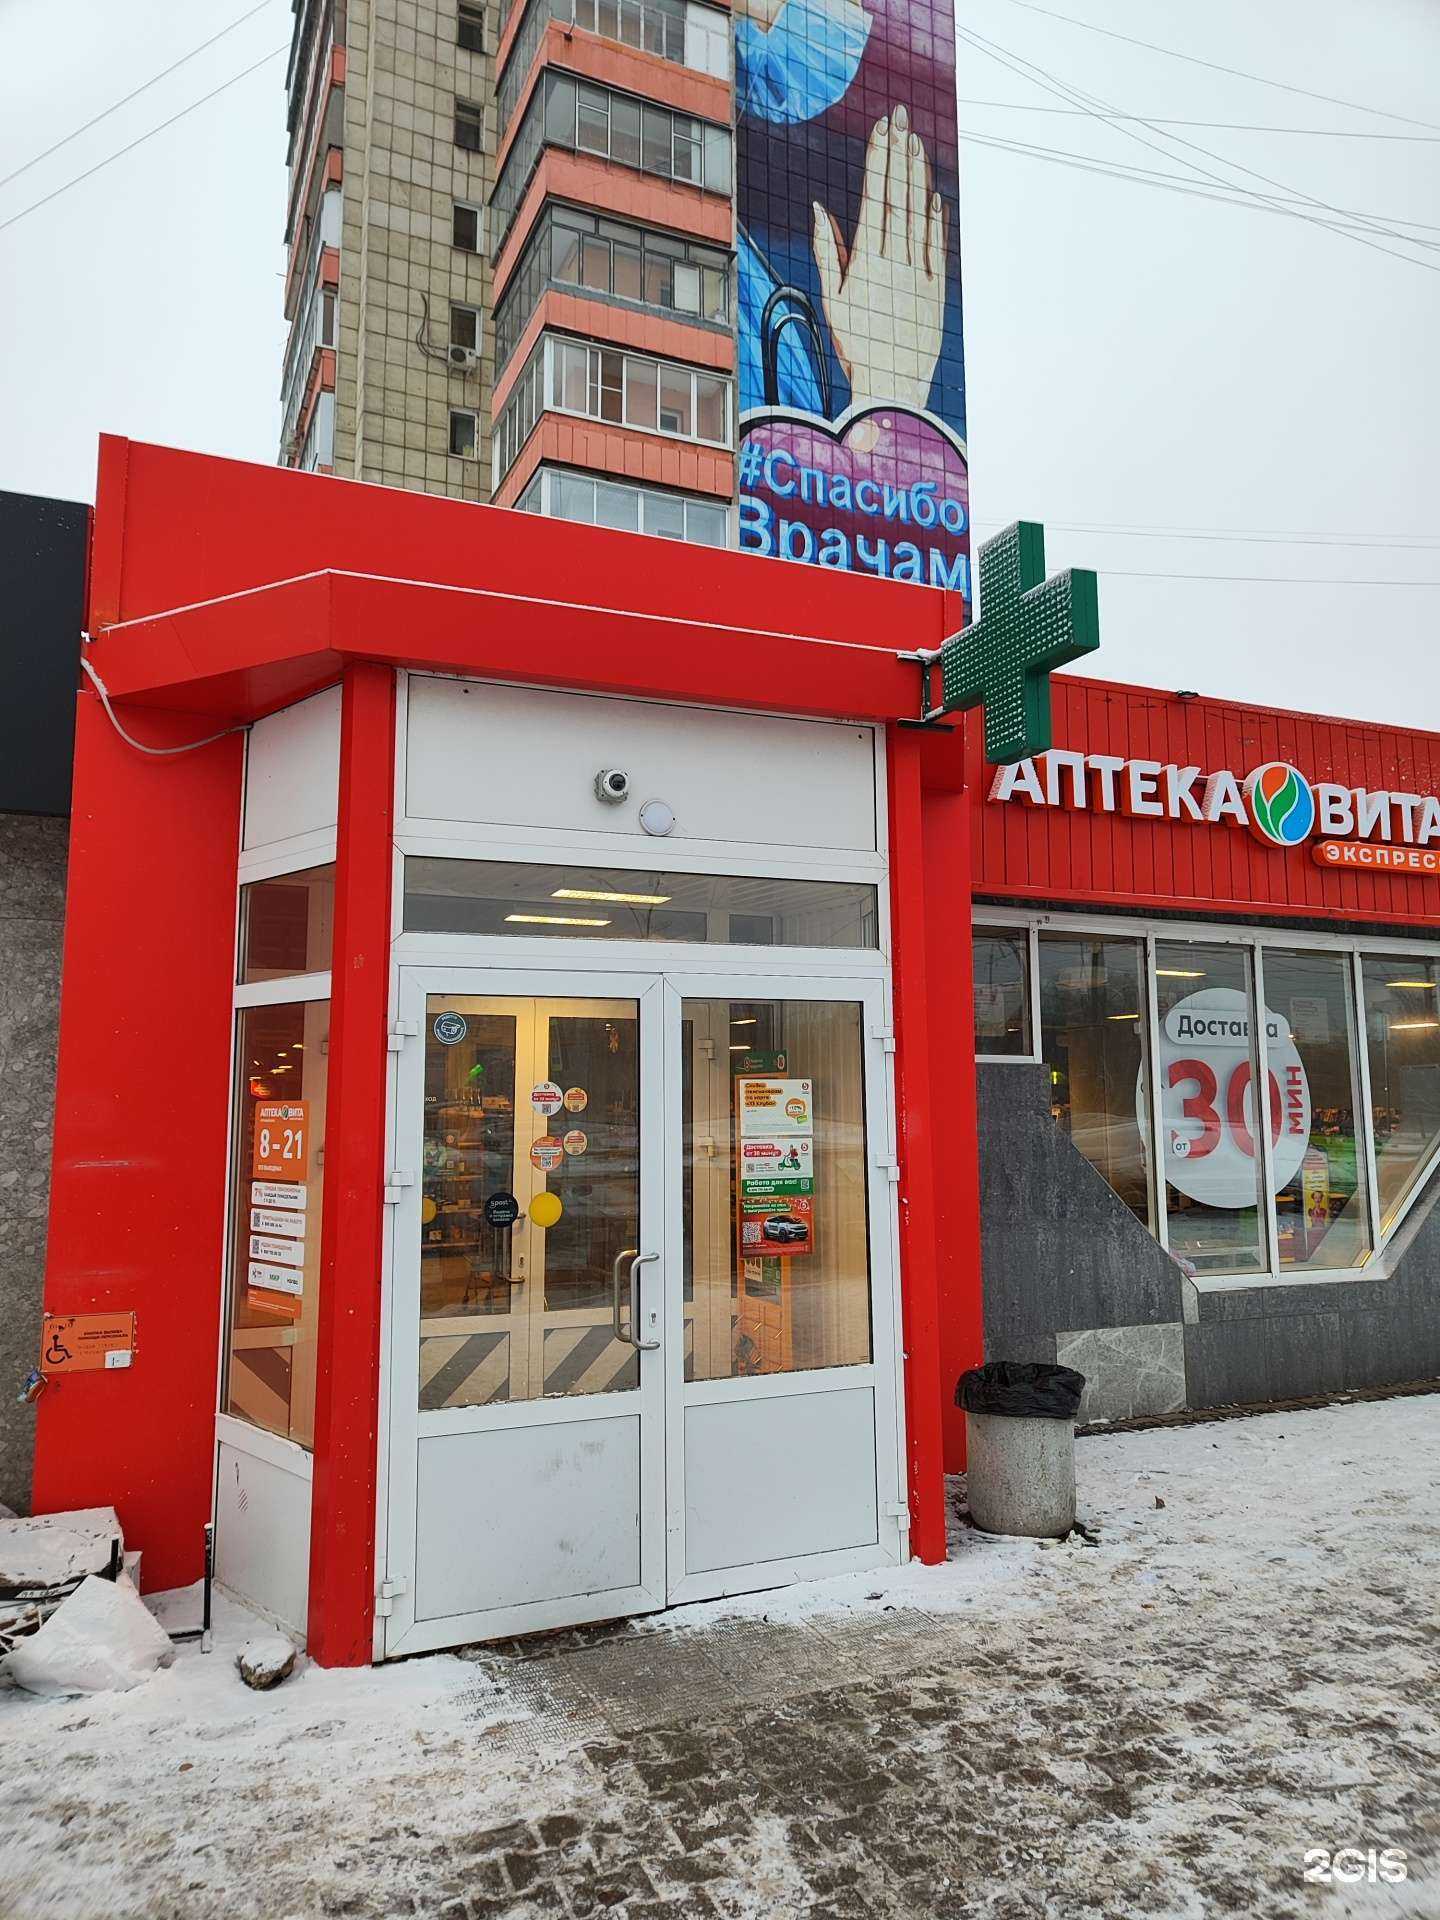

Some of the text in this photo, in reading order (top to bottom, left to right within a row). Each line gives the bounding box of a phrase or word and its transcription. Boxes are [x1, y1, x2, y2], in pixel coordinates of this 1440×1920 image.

[740, 441, 966, 534] #Спасибо
[740, 494, 970, 600] Врачам
[991, 751, 1440, 845] АПТЕКА ВИТА
[1326, 845, 1440, 868] ЭКСПРЕС
[1177, 1015, 1278, 1038] Достаа
[1168, 1058, 1283, 1159] 30
[1286, 1066, 1304, 1134] МИН
